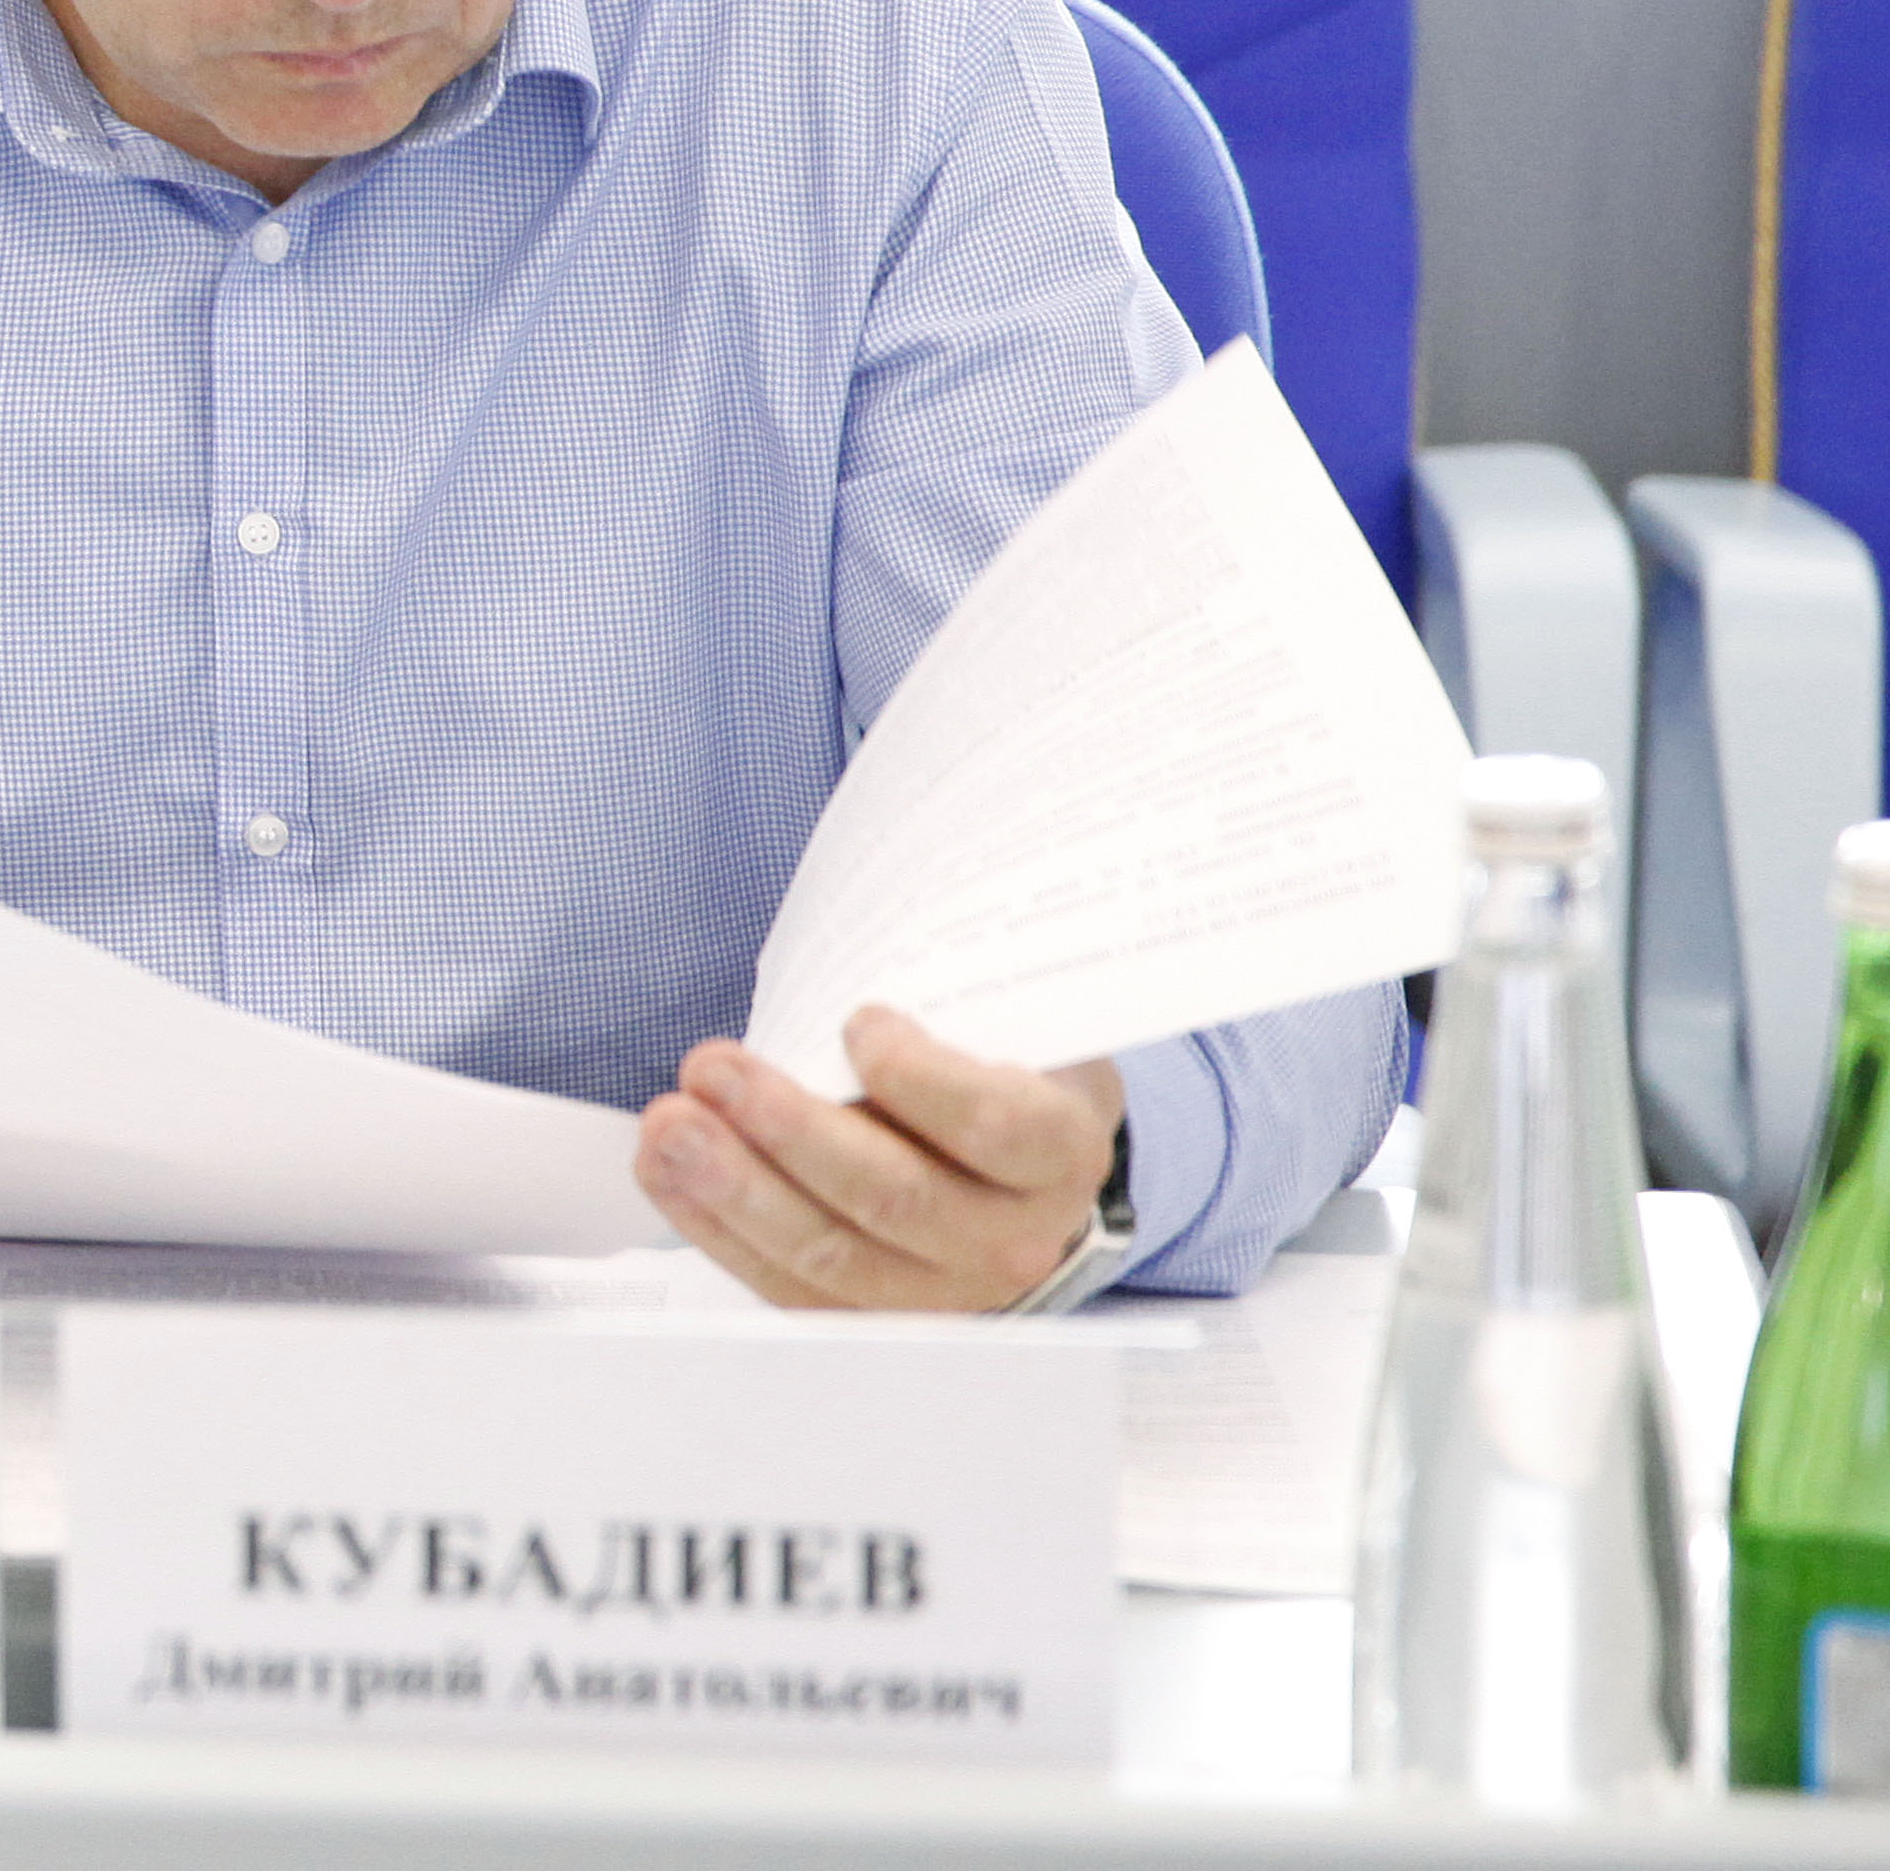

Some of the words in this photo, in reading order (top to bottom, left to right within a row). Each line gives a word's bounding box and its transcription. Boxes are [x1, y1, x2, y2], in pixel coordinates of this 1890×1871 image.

[237, 1515, 927, 1613] КУБАДИЕВ
[132, 1635, 487, 1716] Дмитрий
[512, 1649, 1022, 1719] Анатольевич
